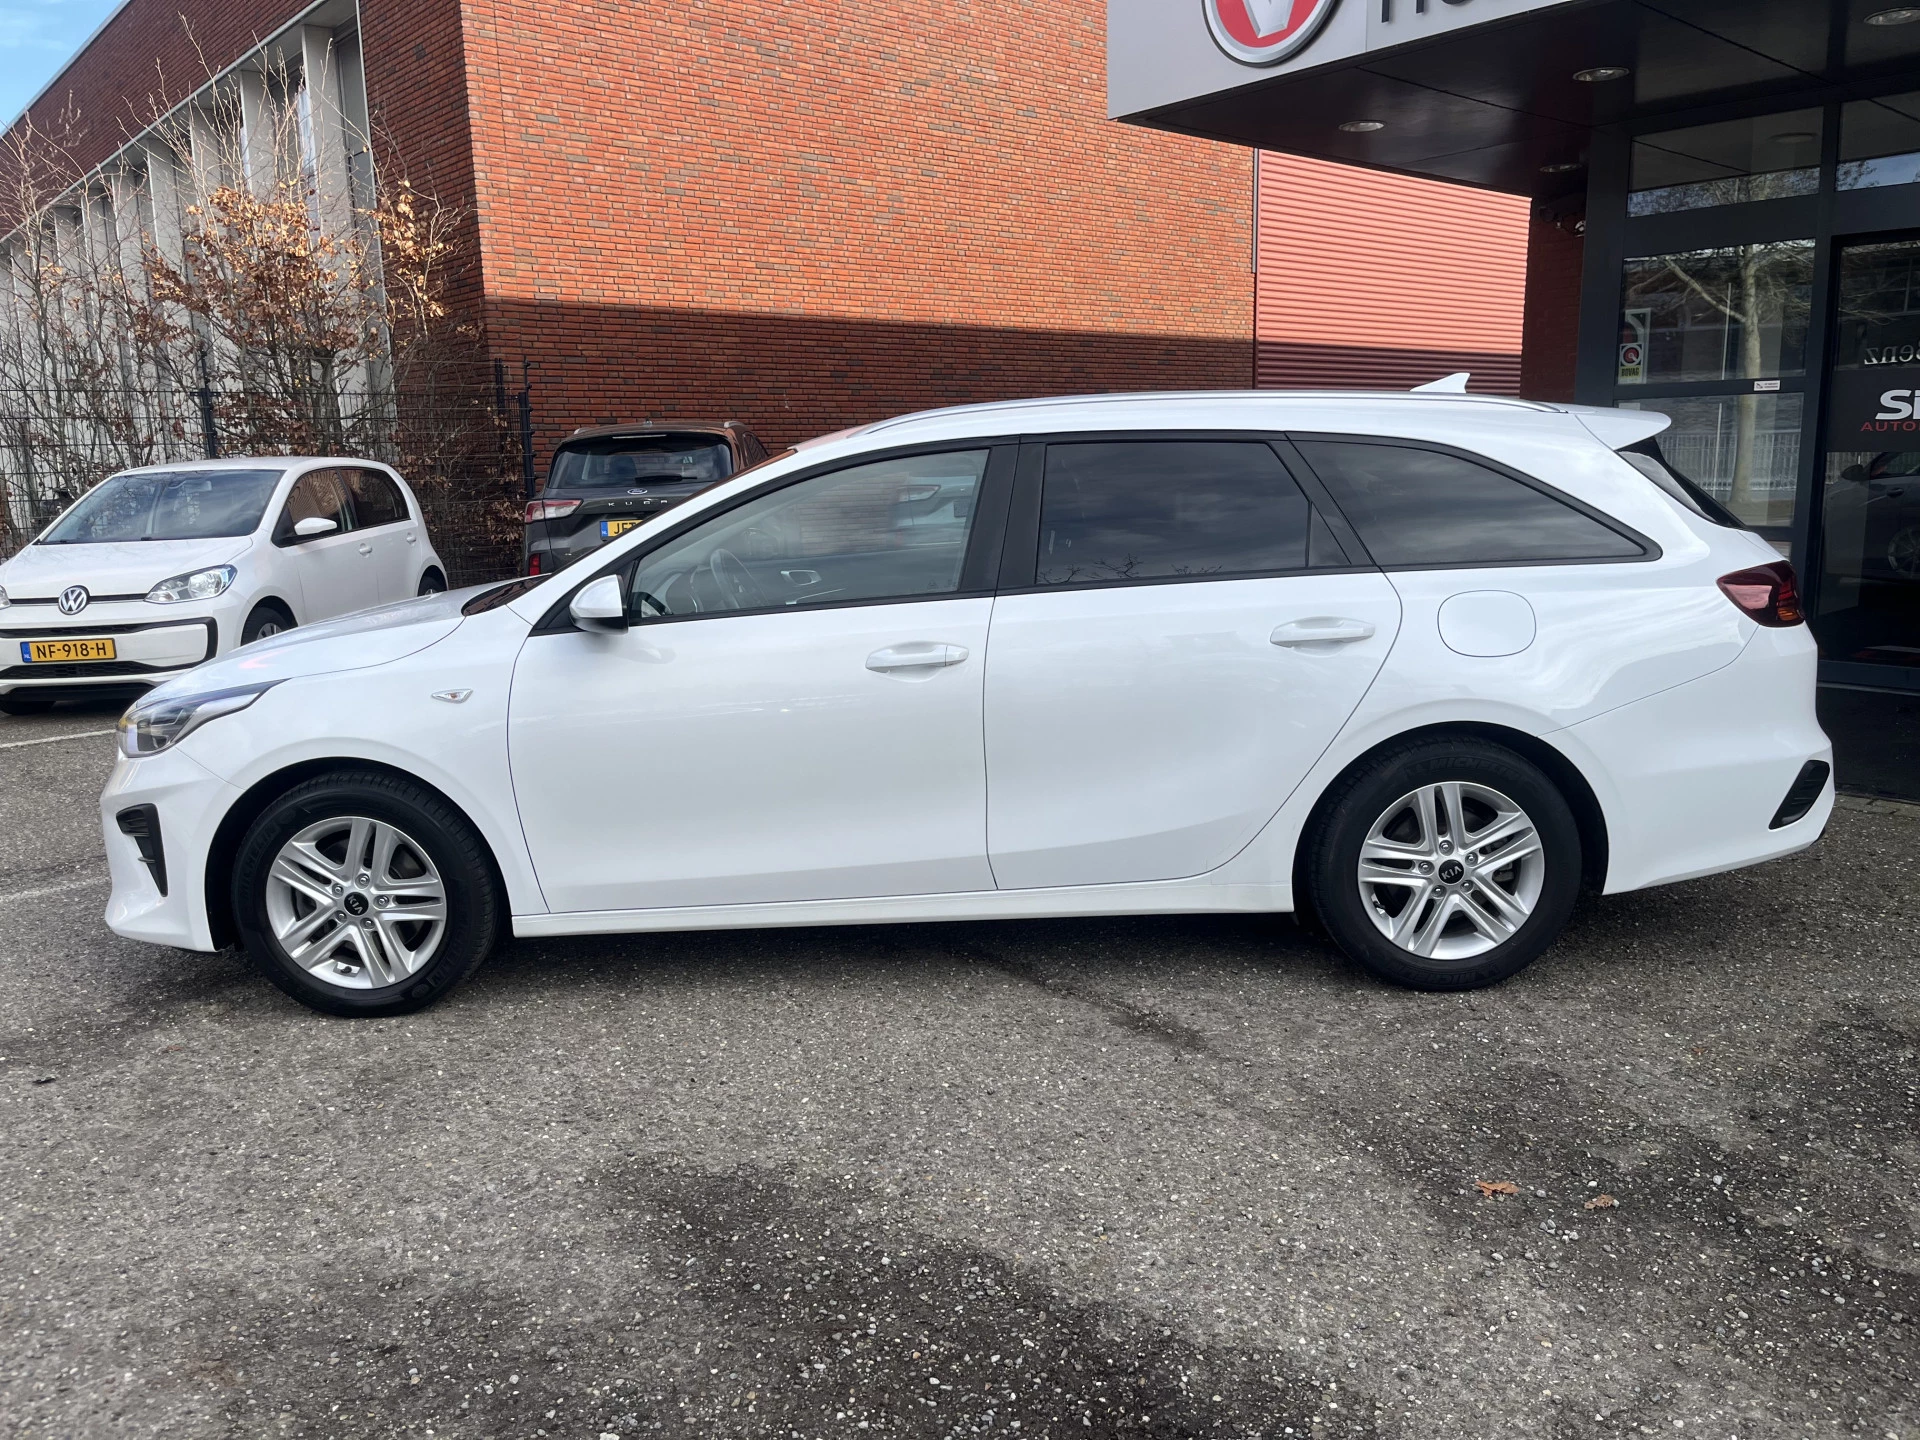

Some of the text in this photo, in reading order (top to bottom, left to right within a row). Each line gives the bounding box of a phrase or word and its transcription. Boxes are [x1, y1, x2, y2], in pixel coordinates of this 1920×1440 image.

[1861, 421, 1920, 432] AUTO
[36, 642, 107, 658] NF-918-H
[1441, 865, 1463, 880] KIA
[347, 894, 363, 914] KIA
